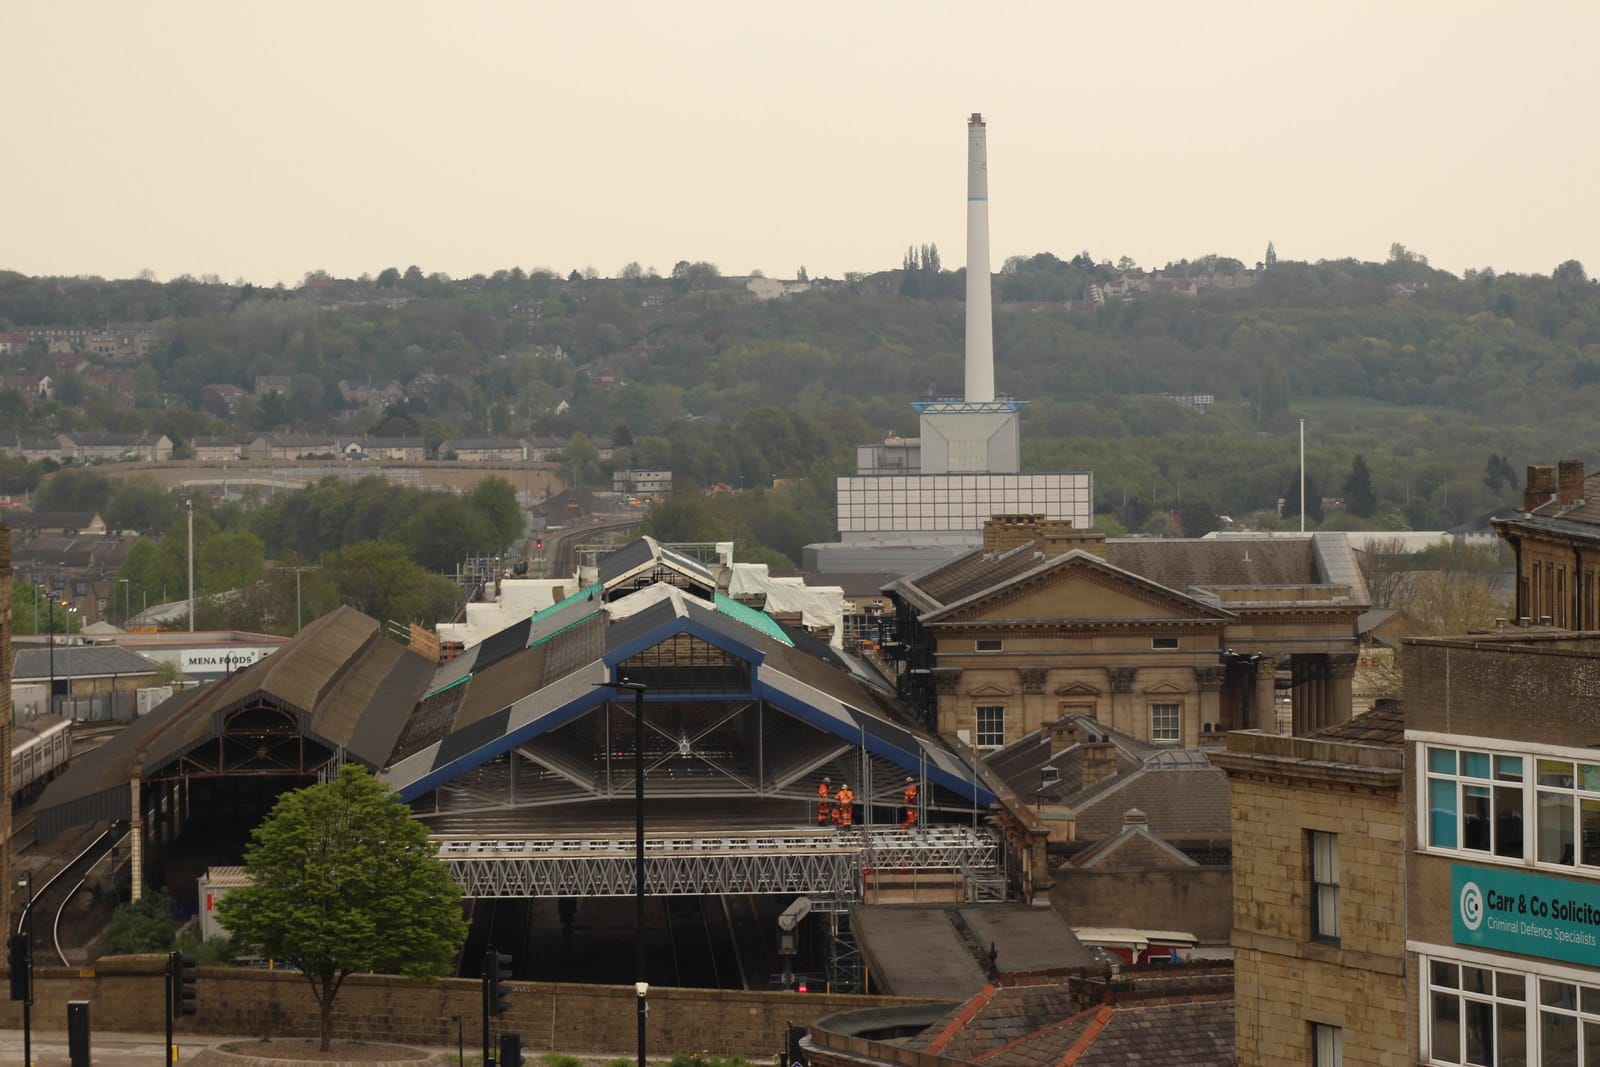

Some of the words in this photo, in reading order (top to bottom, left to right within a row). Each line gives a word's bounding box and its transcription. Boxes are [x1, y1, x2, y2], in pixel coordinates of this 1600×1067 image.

[188, 657, 217, 665] MENA
[219, 656, 252, 665] FOODS
[1487, 889, 1515, 912] Carr
[1518, 893, 1527, 914] &
[1530, 895, 1548, 917] Co
[1487, 916, 1519, 933] Criminal
[1520, 921, 1553, 939] Defence
[1554, 927, 1596, 946] Specialists
